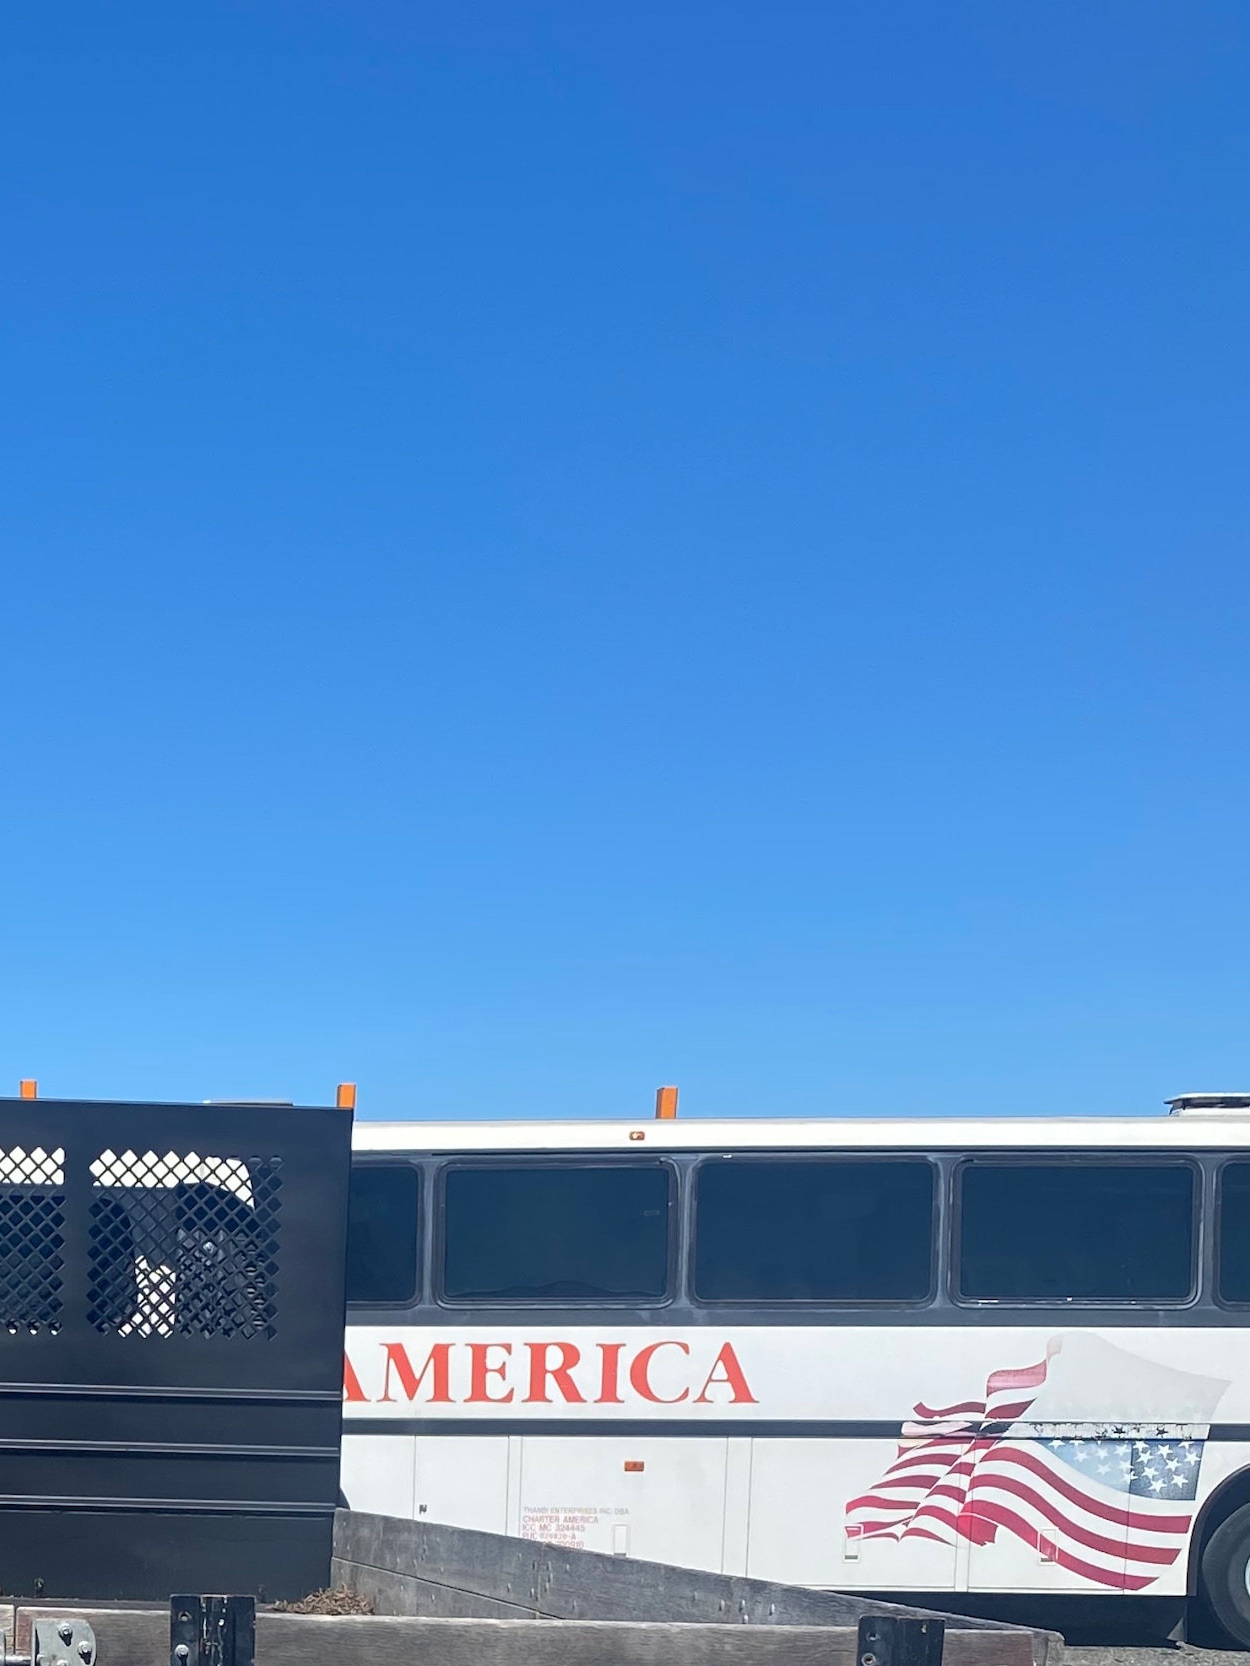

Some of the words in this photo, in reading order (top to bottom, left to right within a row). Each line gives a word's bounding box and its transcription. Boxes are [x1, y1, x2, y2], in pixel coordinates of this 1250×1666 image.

[343, 1341, 759, 1405] AMERICA
[522, 1515, 560, 1523] CHARTER
[562, 1515, 599, 1524] AMERICA
[538, 1523, 552, 1532] MC
